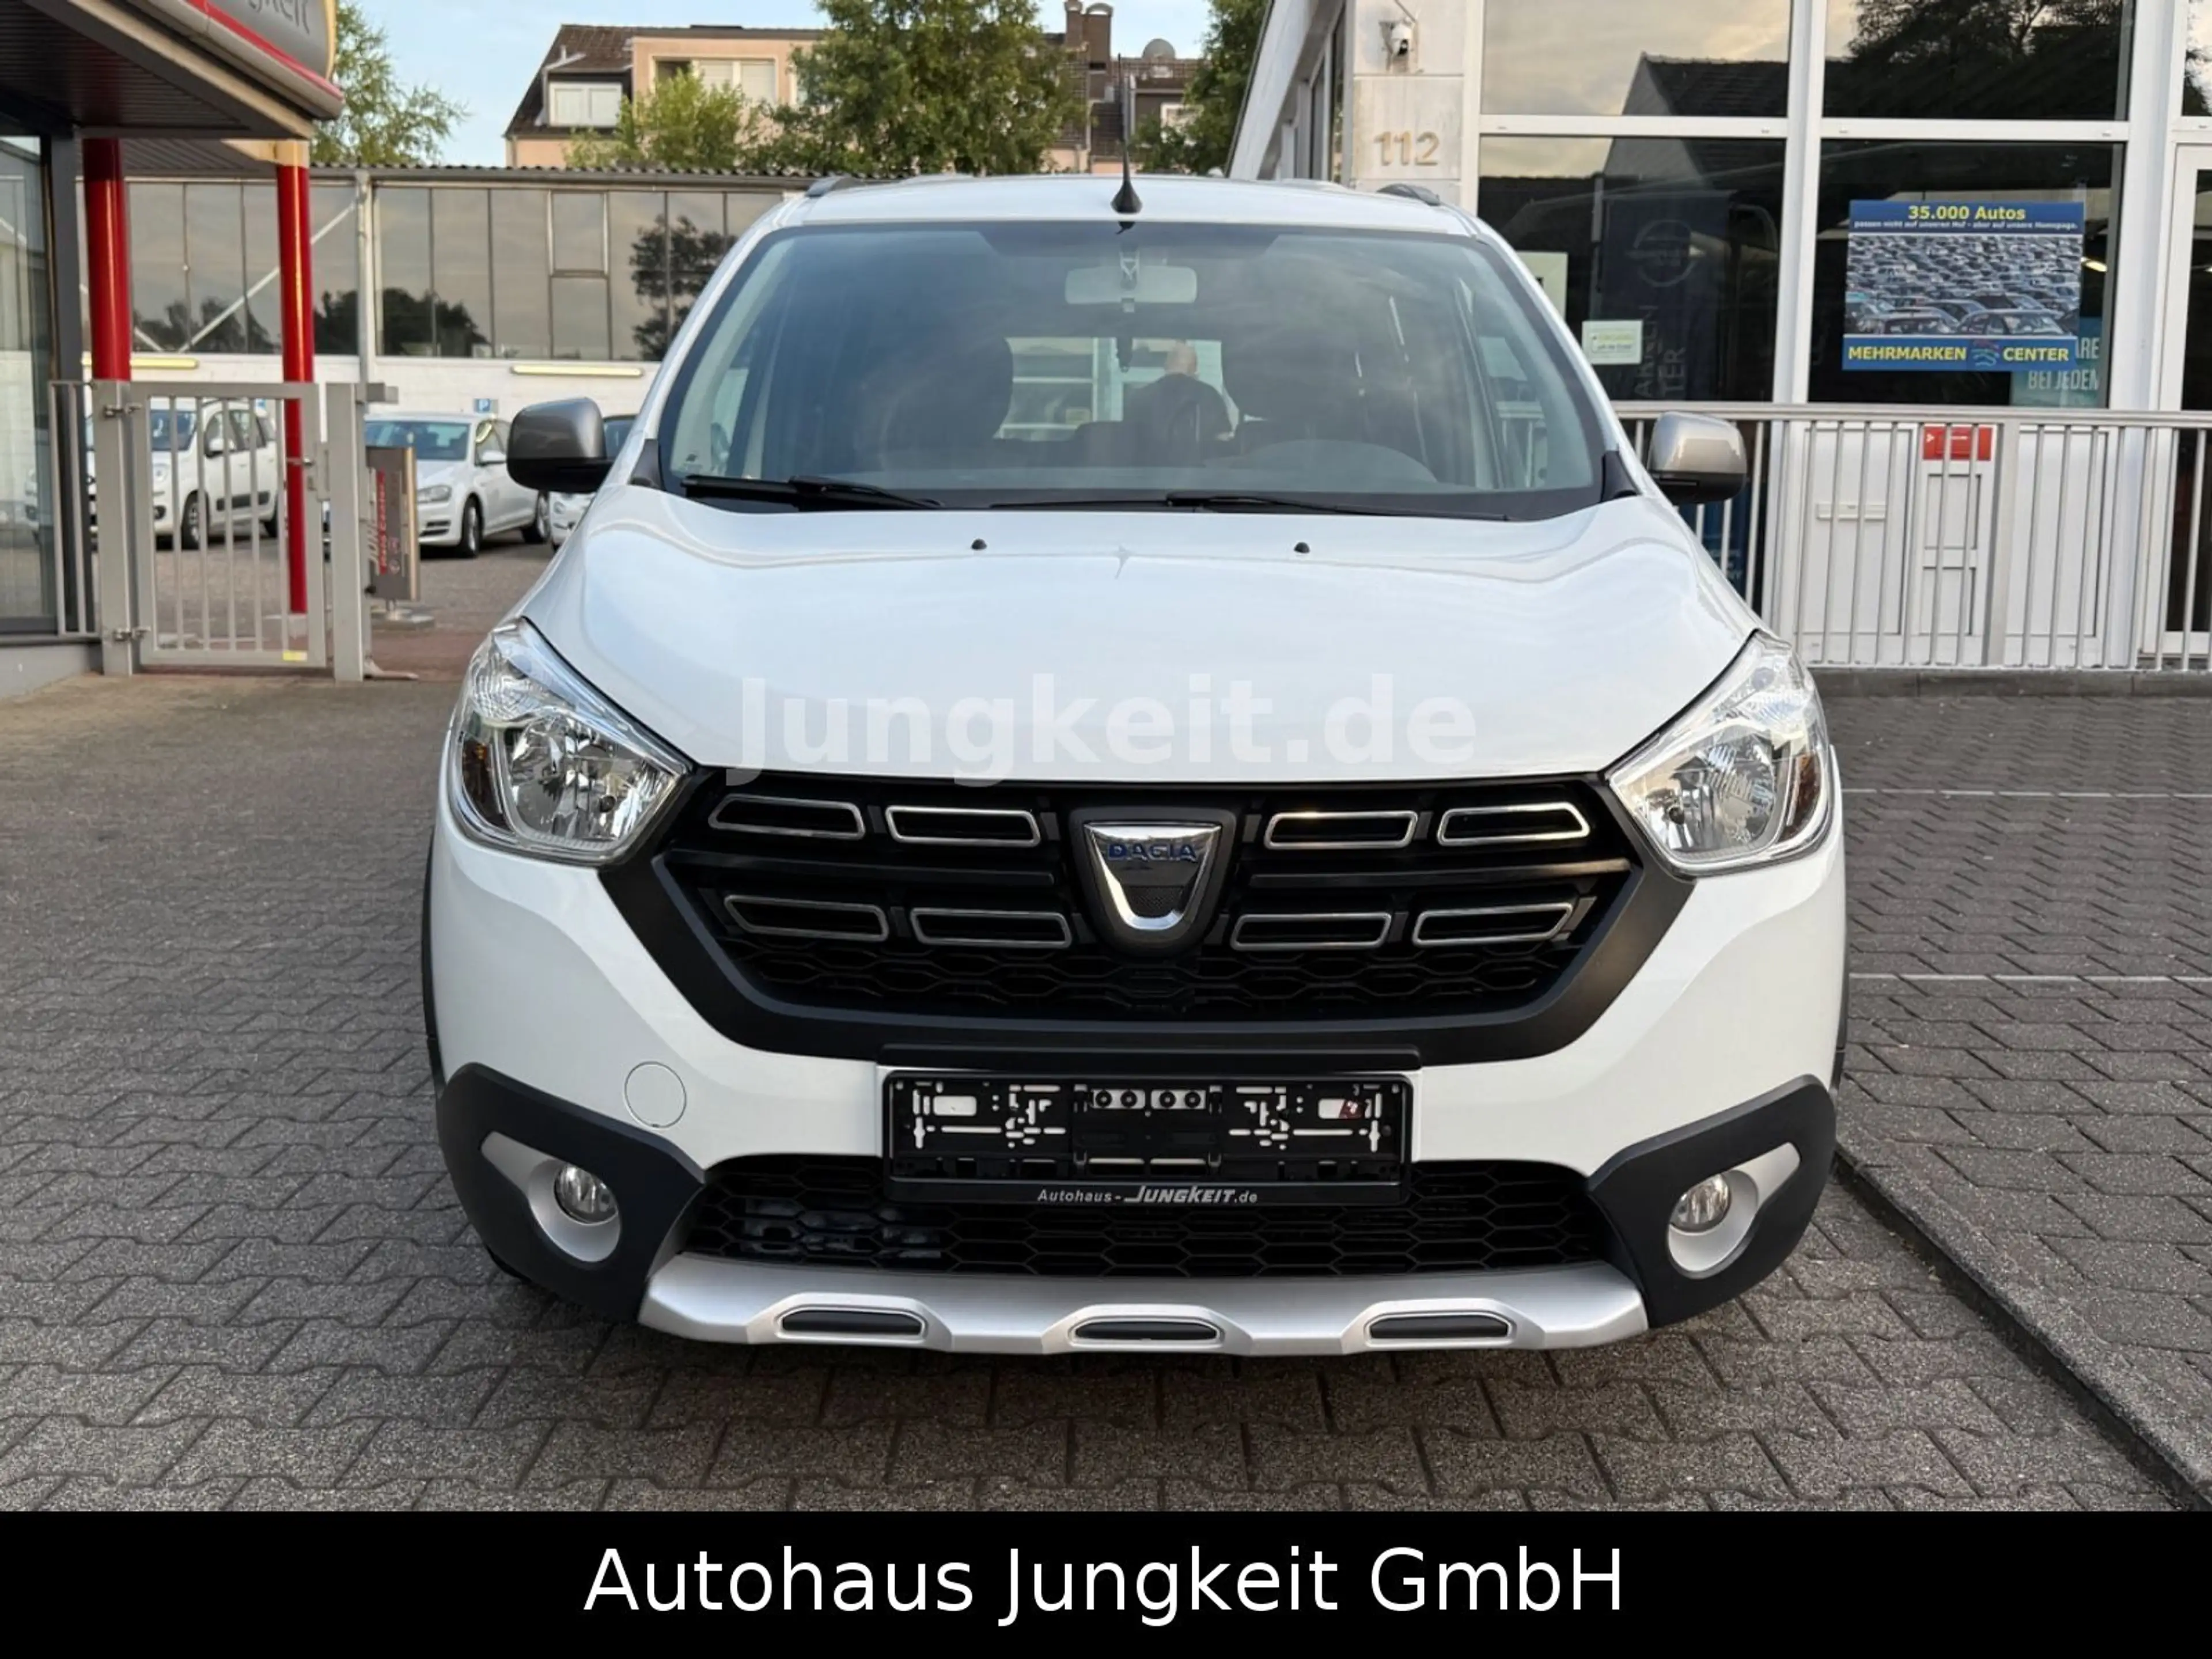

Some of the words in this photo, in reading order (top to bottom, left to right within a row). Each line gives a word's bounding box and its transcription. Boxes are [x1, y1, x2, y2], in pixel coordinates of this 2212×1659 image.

[1373, 131, 1440, 166] 112
[1908, 205, 1969, 219] 35.000
[1975, 206, 2026, 219] Autos
[1847, 347, 1967, 361] MEHRMARKEN
[2002, 348, 2069, 362] CENTER
[2028, 370, 2051, 390] BEI
[1108, 843, 1198, 861] DACIA
